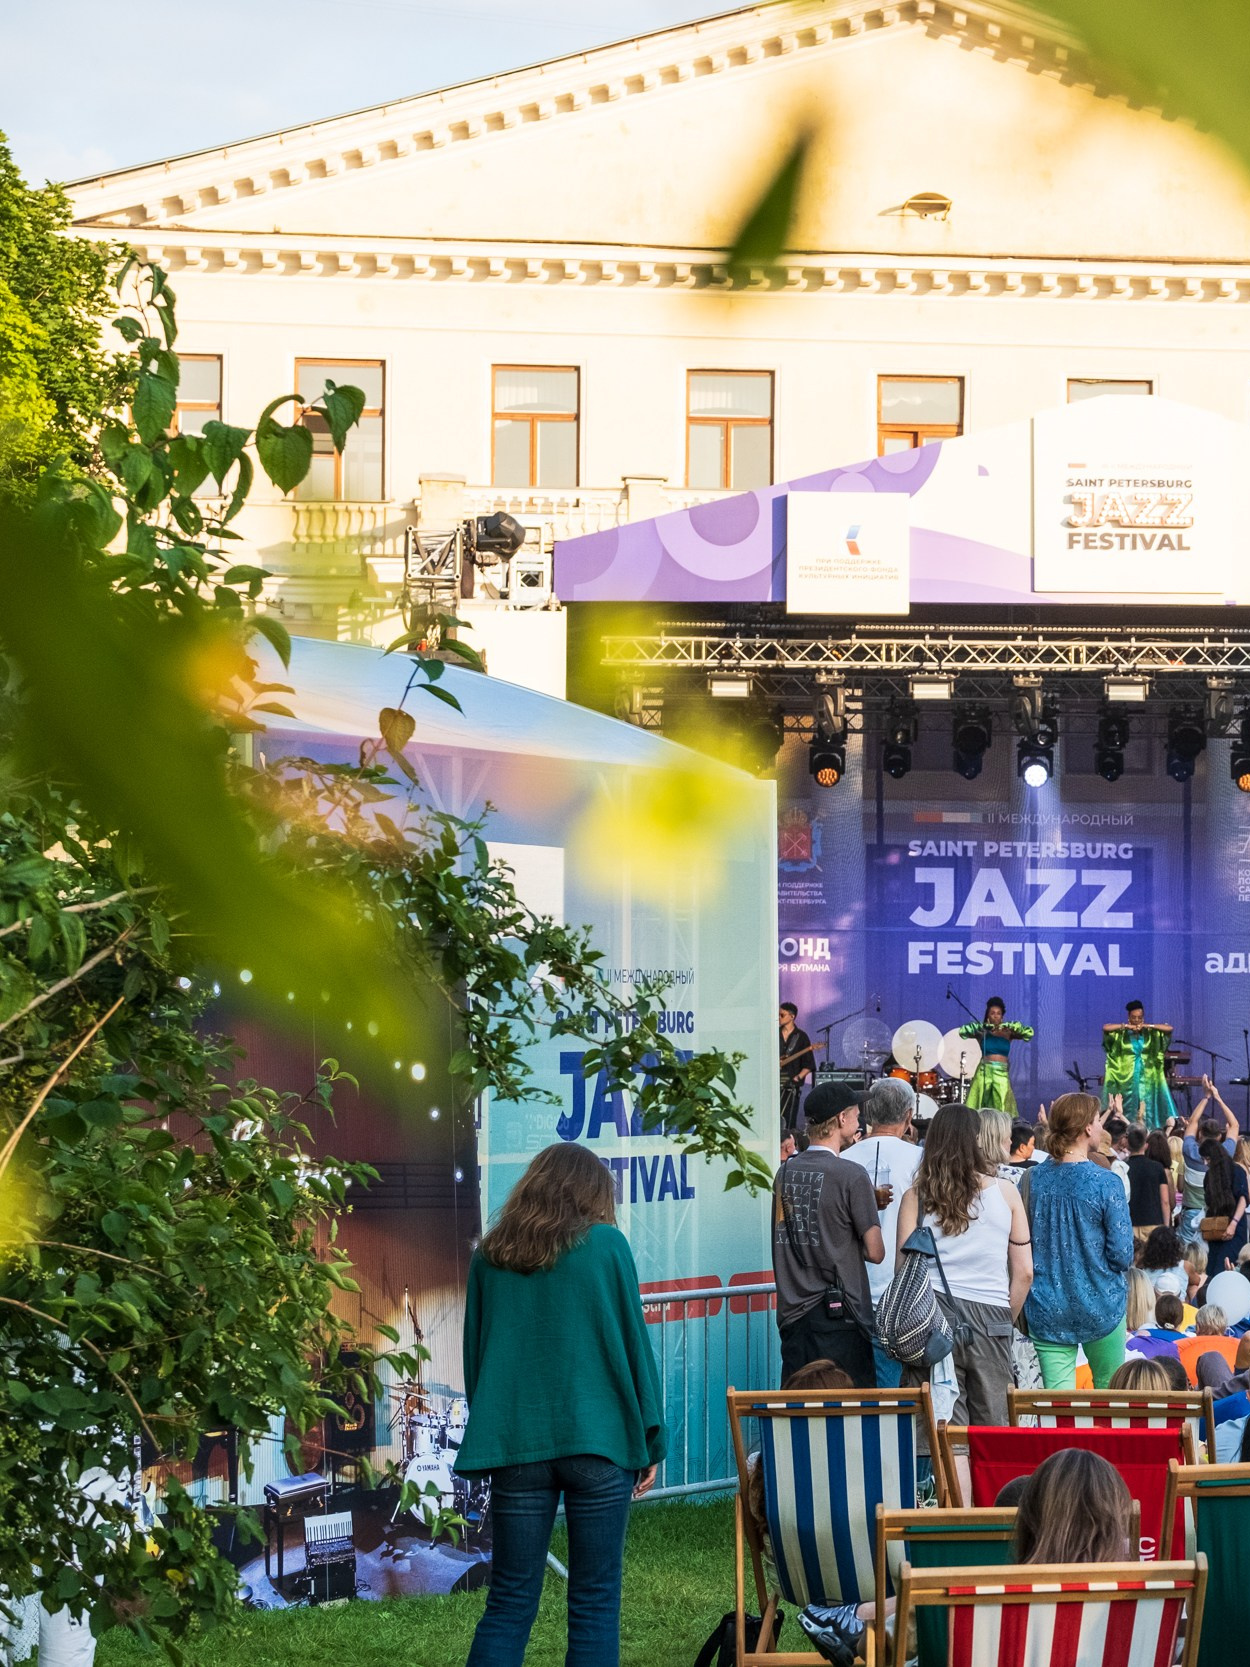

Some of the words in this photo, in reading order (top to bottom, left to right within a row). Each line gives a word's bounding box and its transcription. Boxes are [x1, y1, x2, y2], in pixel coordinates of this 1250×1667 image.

[1066, 479, 1105, 488] SAINT
[1109, 479, 1193, 489] PETERSBURG
[1064, 492, 1194, 529] JAZZ
[1067, 532, 1192, 551] FESTIVAL
[1000, 813, 1134, 826] МЕЖДУНАРОДНЫЙ
[908, 840, 978, 857] SAINT
[984, 841, 1134, 859] PETERSBURG
[909, 867, 1134, 929] JAZZ
[778, 937, 831, 960] ОНД
[790, 963, 831, 972] БУТМАНА
[907, 941, 1134, 977] FESTIVAL
